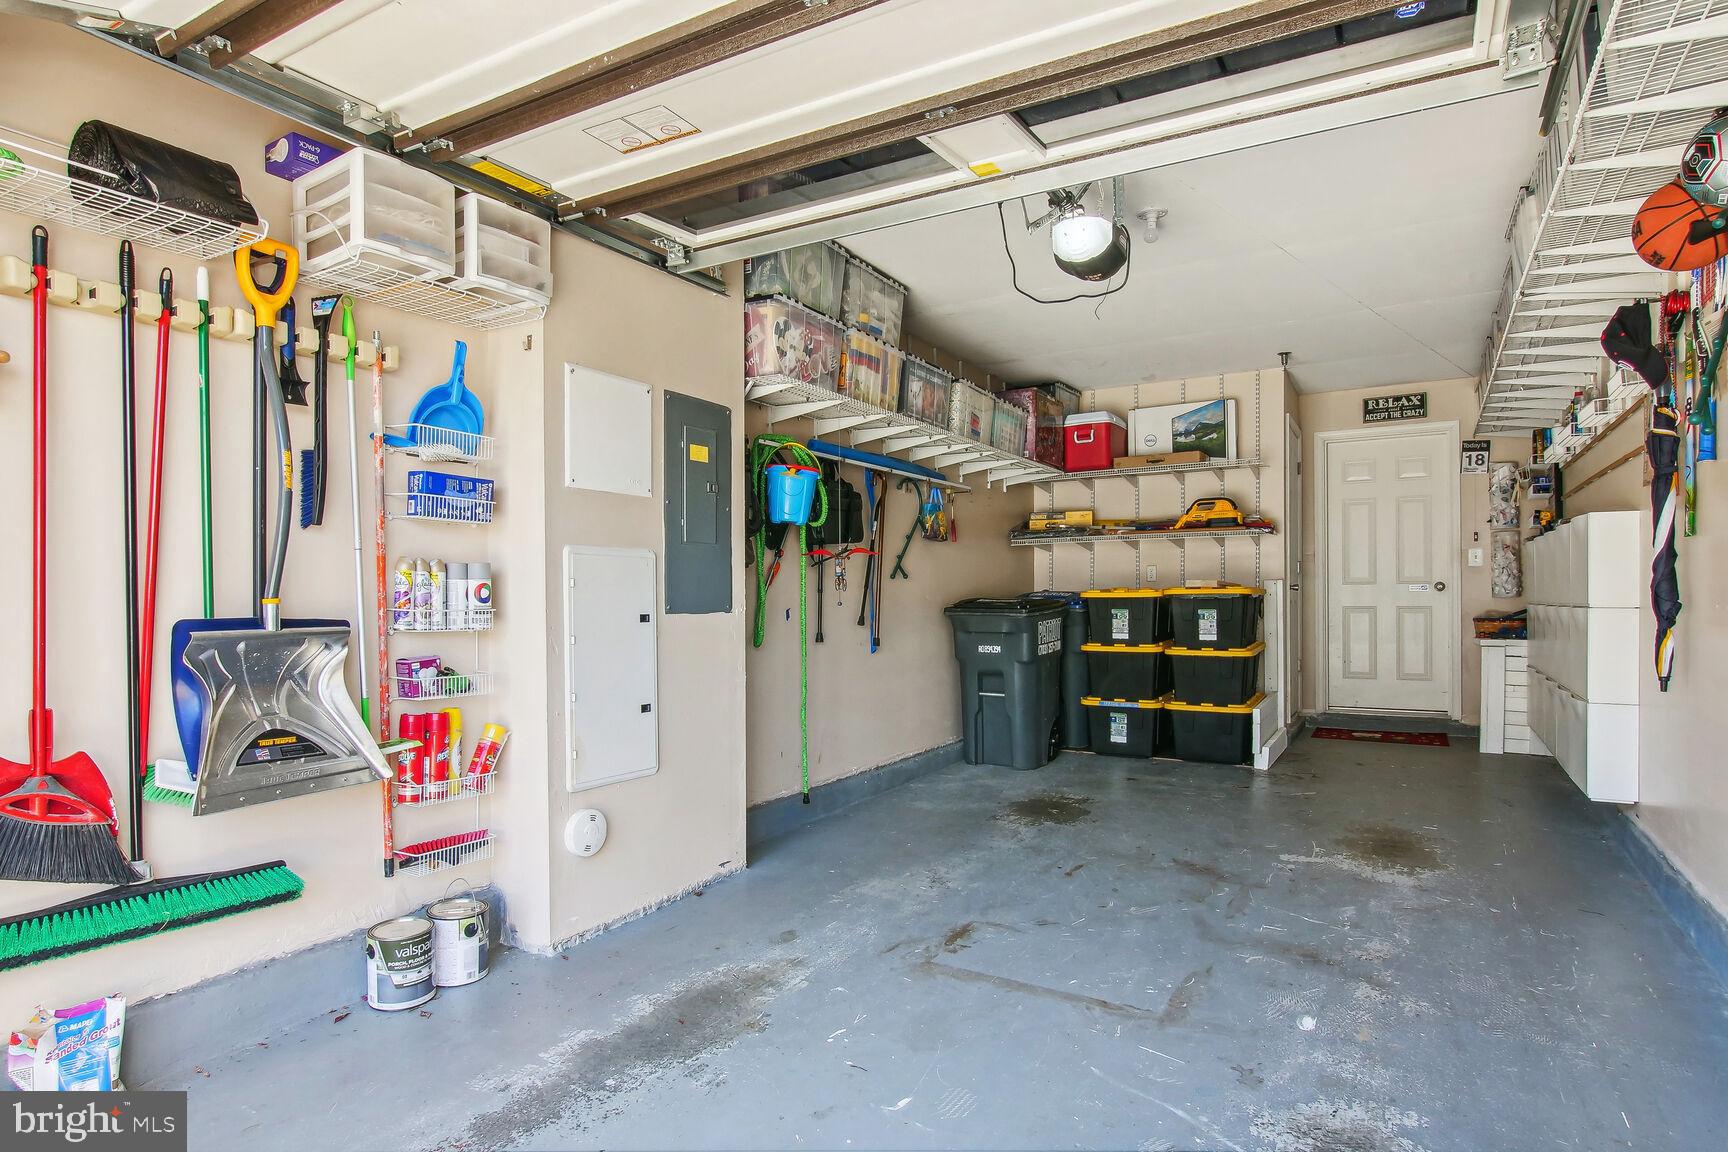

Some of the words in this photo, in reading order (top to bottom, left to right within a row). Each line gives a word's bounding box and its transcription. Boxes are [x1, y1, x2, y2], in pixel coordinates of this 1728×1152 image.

[299, 140, 320, 153] 6-PACK
[1367, 395, 1421, 410] RELAX
[1366, 412, 1388, 420] ACCEPT
[1390, 410, 1401, 418] THE
[1403, 408, 1424, 417] CRAZY
[1465, 453, 1485, 466] 18
[258, 739, 274, 747] TRUE
[274, 736, 297, 745] TEMPER
[45, 1038, 88, 1064] Sanded
[90, 1018, 121, 1042] Grout
